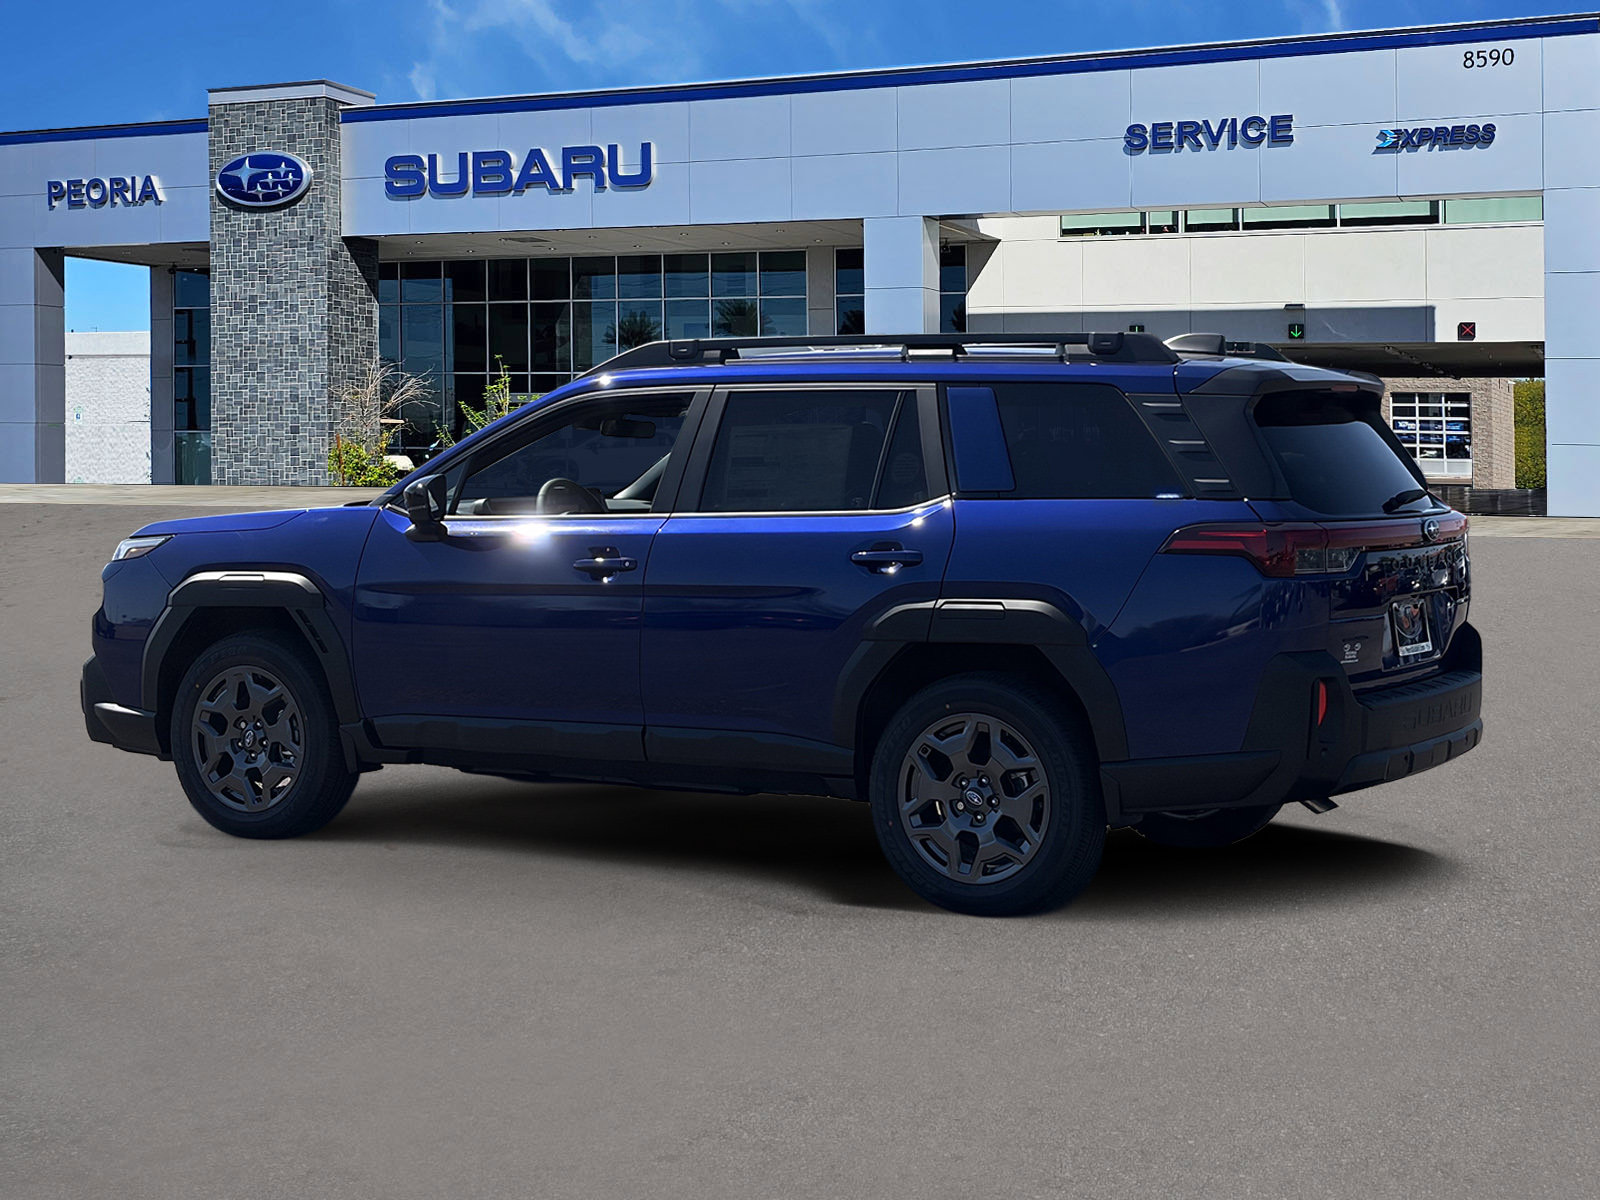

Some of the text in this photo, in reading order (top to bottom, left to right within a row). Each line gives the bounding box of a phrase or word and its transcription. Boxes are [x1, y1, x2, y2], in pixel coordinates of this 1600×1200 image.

[1463, 48, 1514, 69] 8590
[1125, 114, 1294, 152] SERVICE
[1375, 123, 1497, 151] EXPRESS
[385, 142, 653, 198] SUBARU
[48, 175, 162, 208] PEORIA
